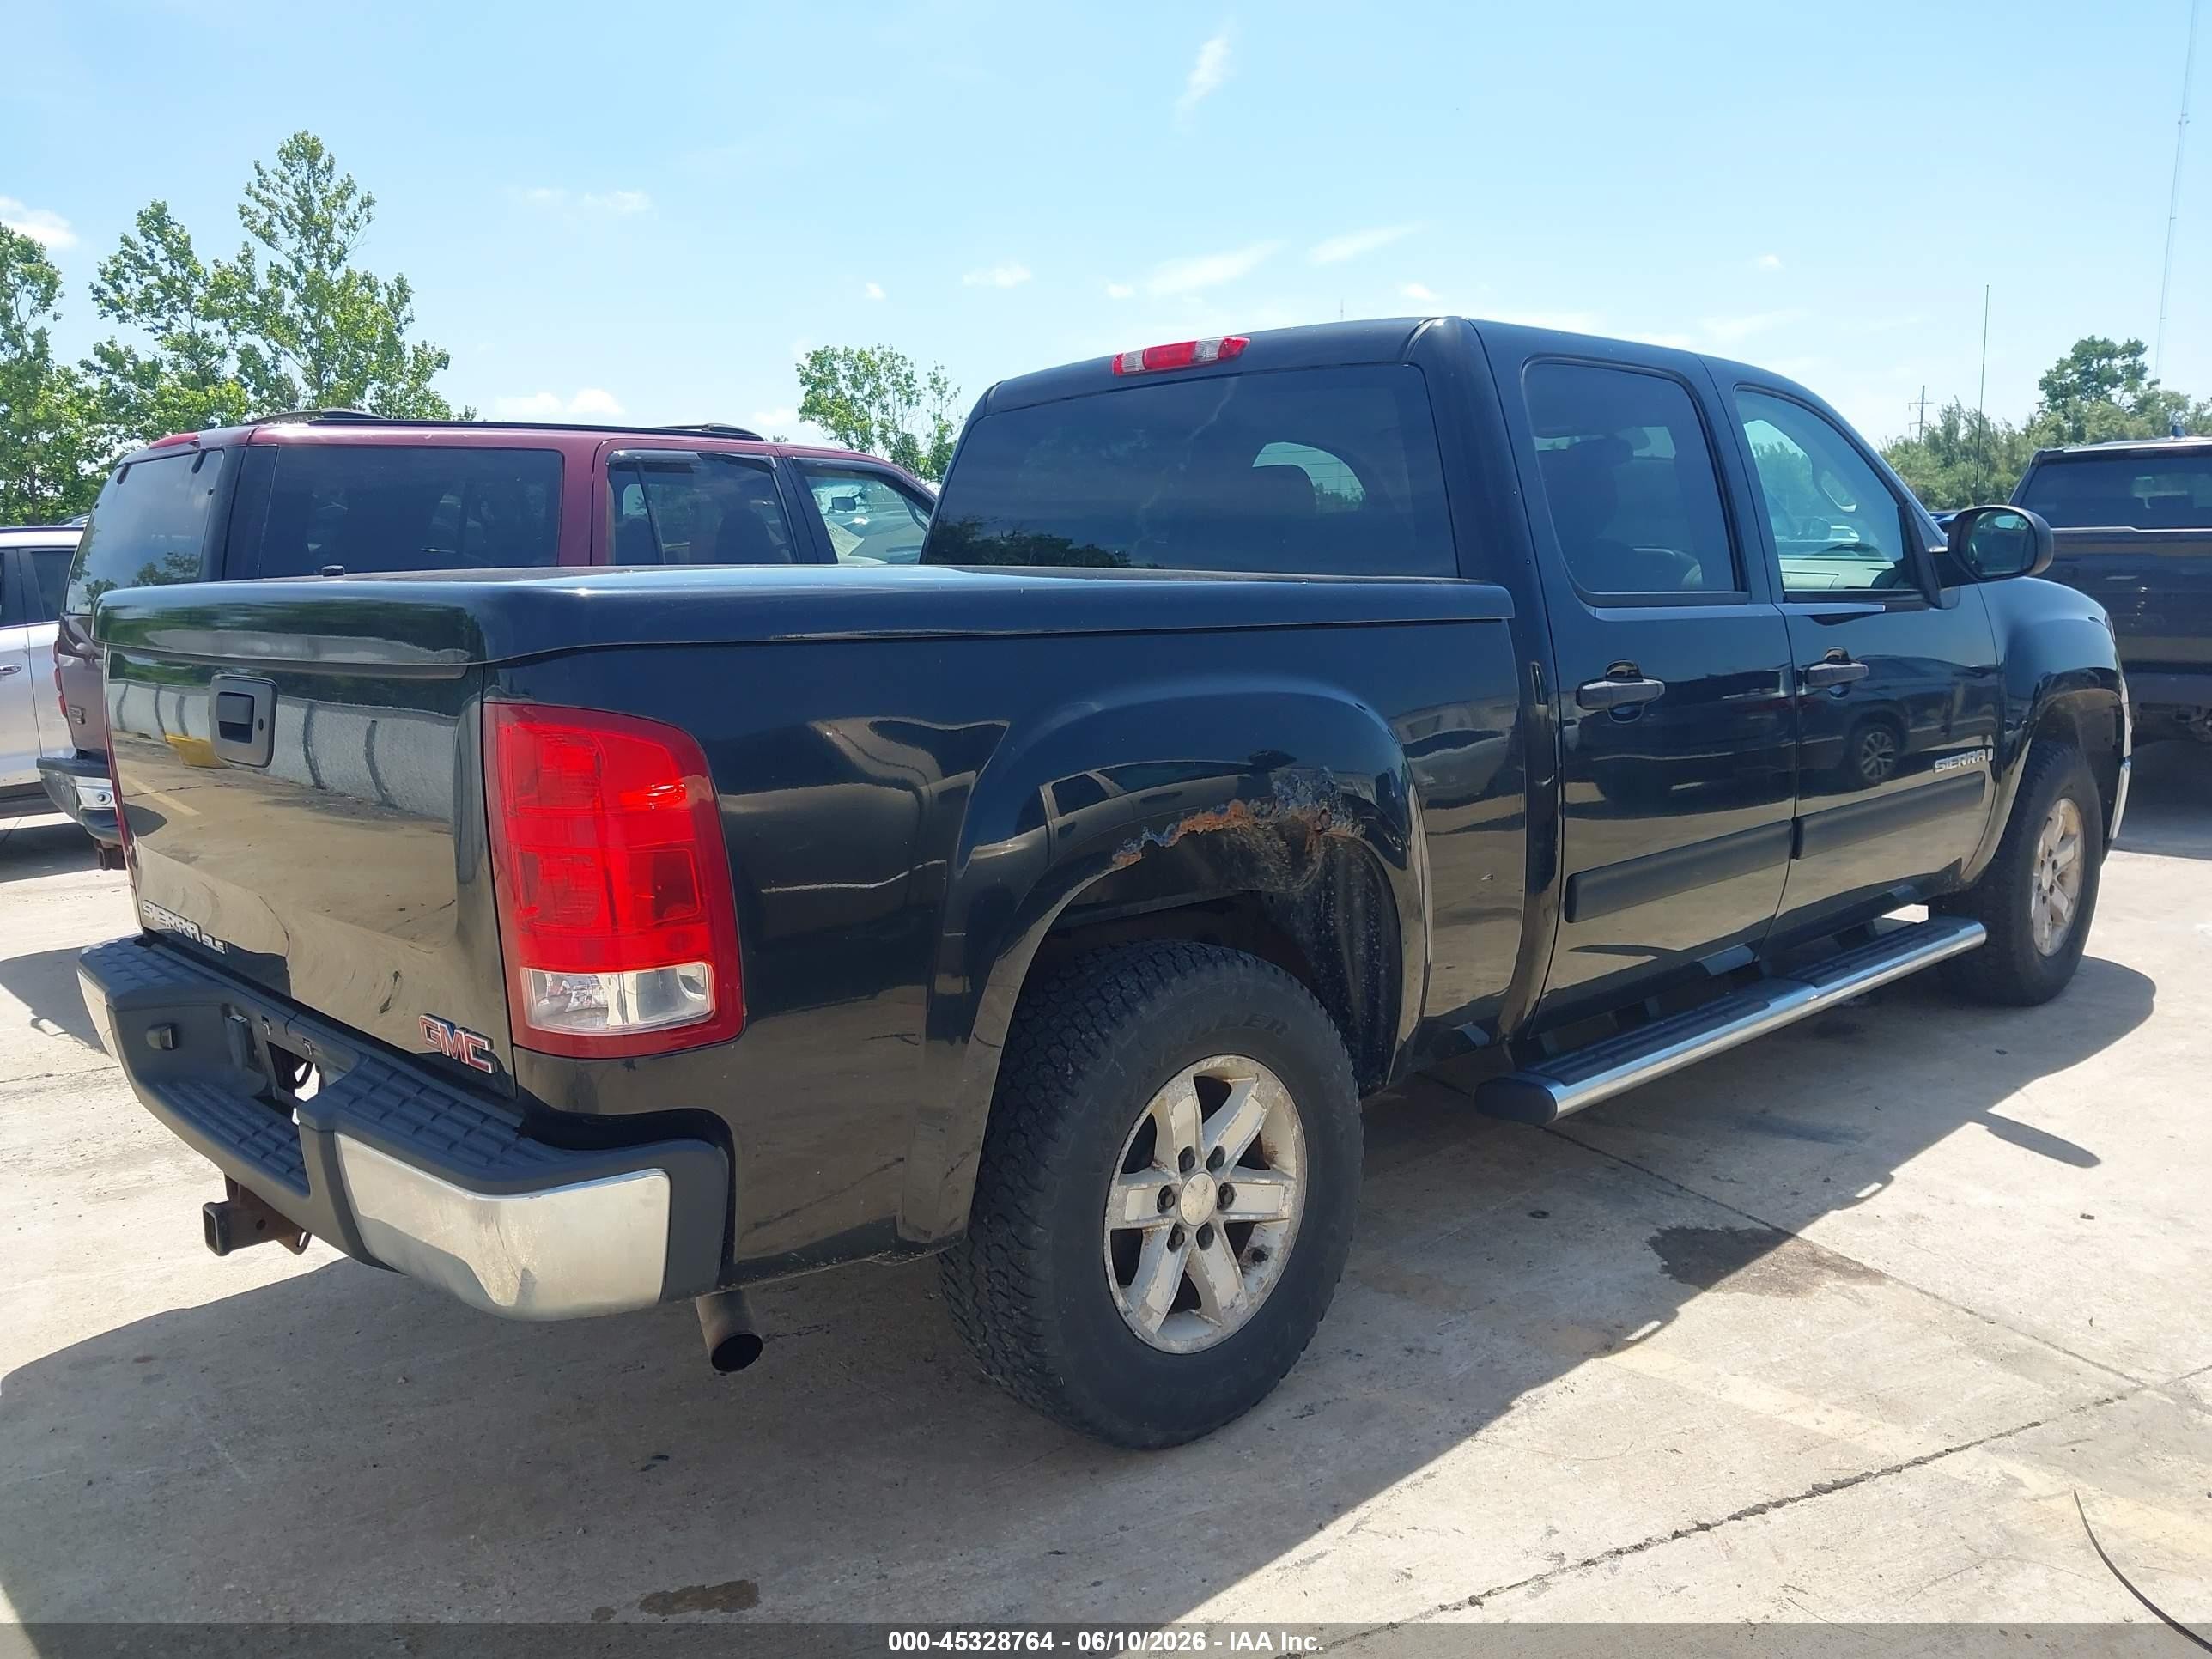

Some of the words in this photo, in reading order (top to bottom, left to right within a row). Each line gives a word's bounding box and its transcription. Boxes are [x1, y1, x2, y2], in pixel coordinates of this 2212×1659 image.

[1934, 748, 1986, 773] SIERRA
[142, 900, 202, 943] SIERRA
[419, 1013, 494, 1074] GMC
